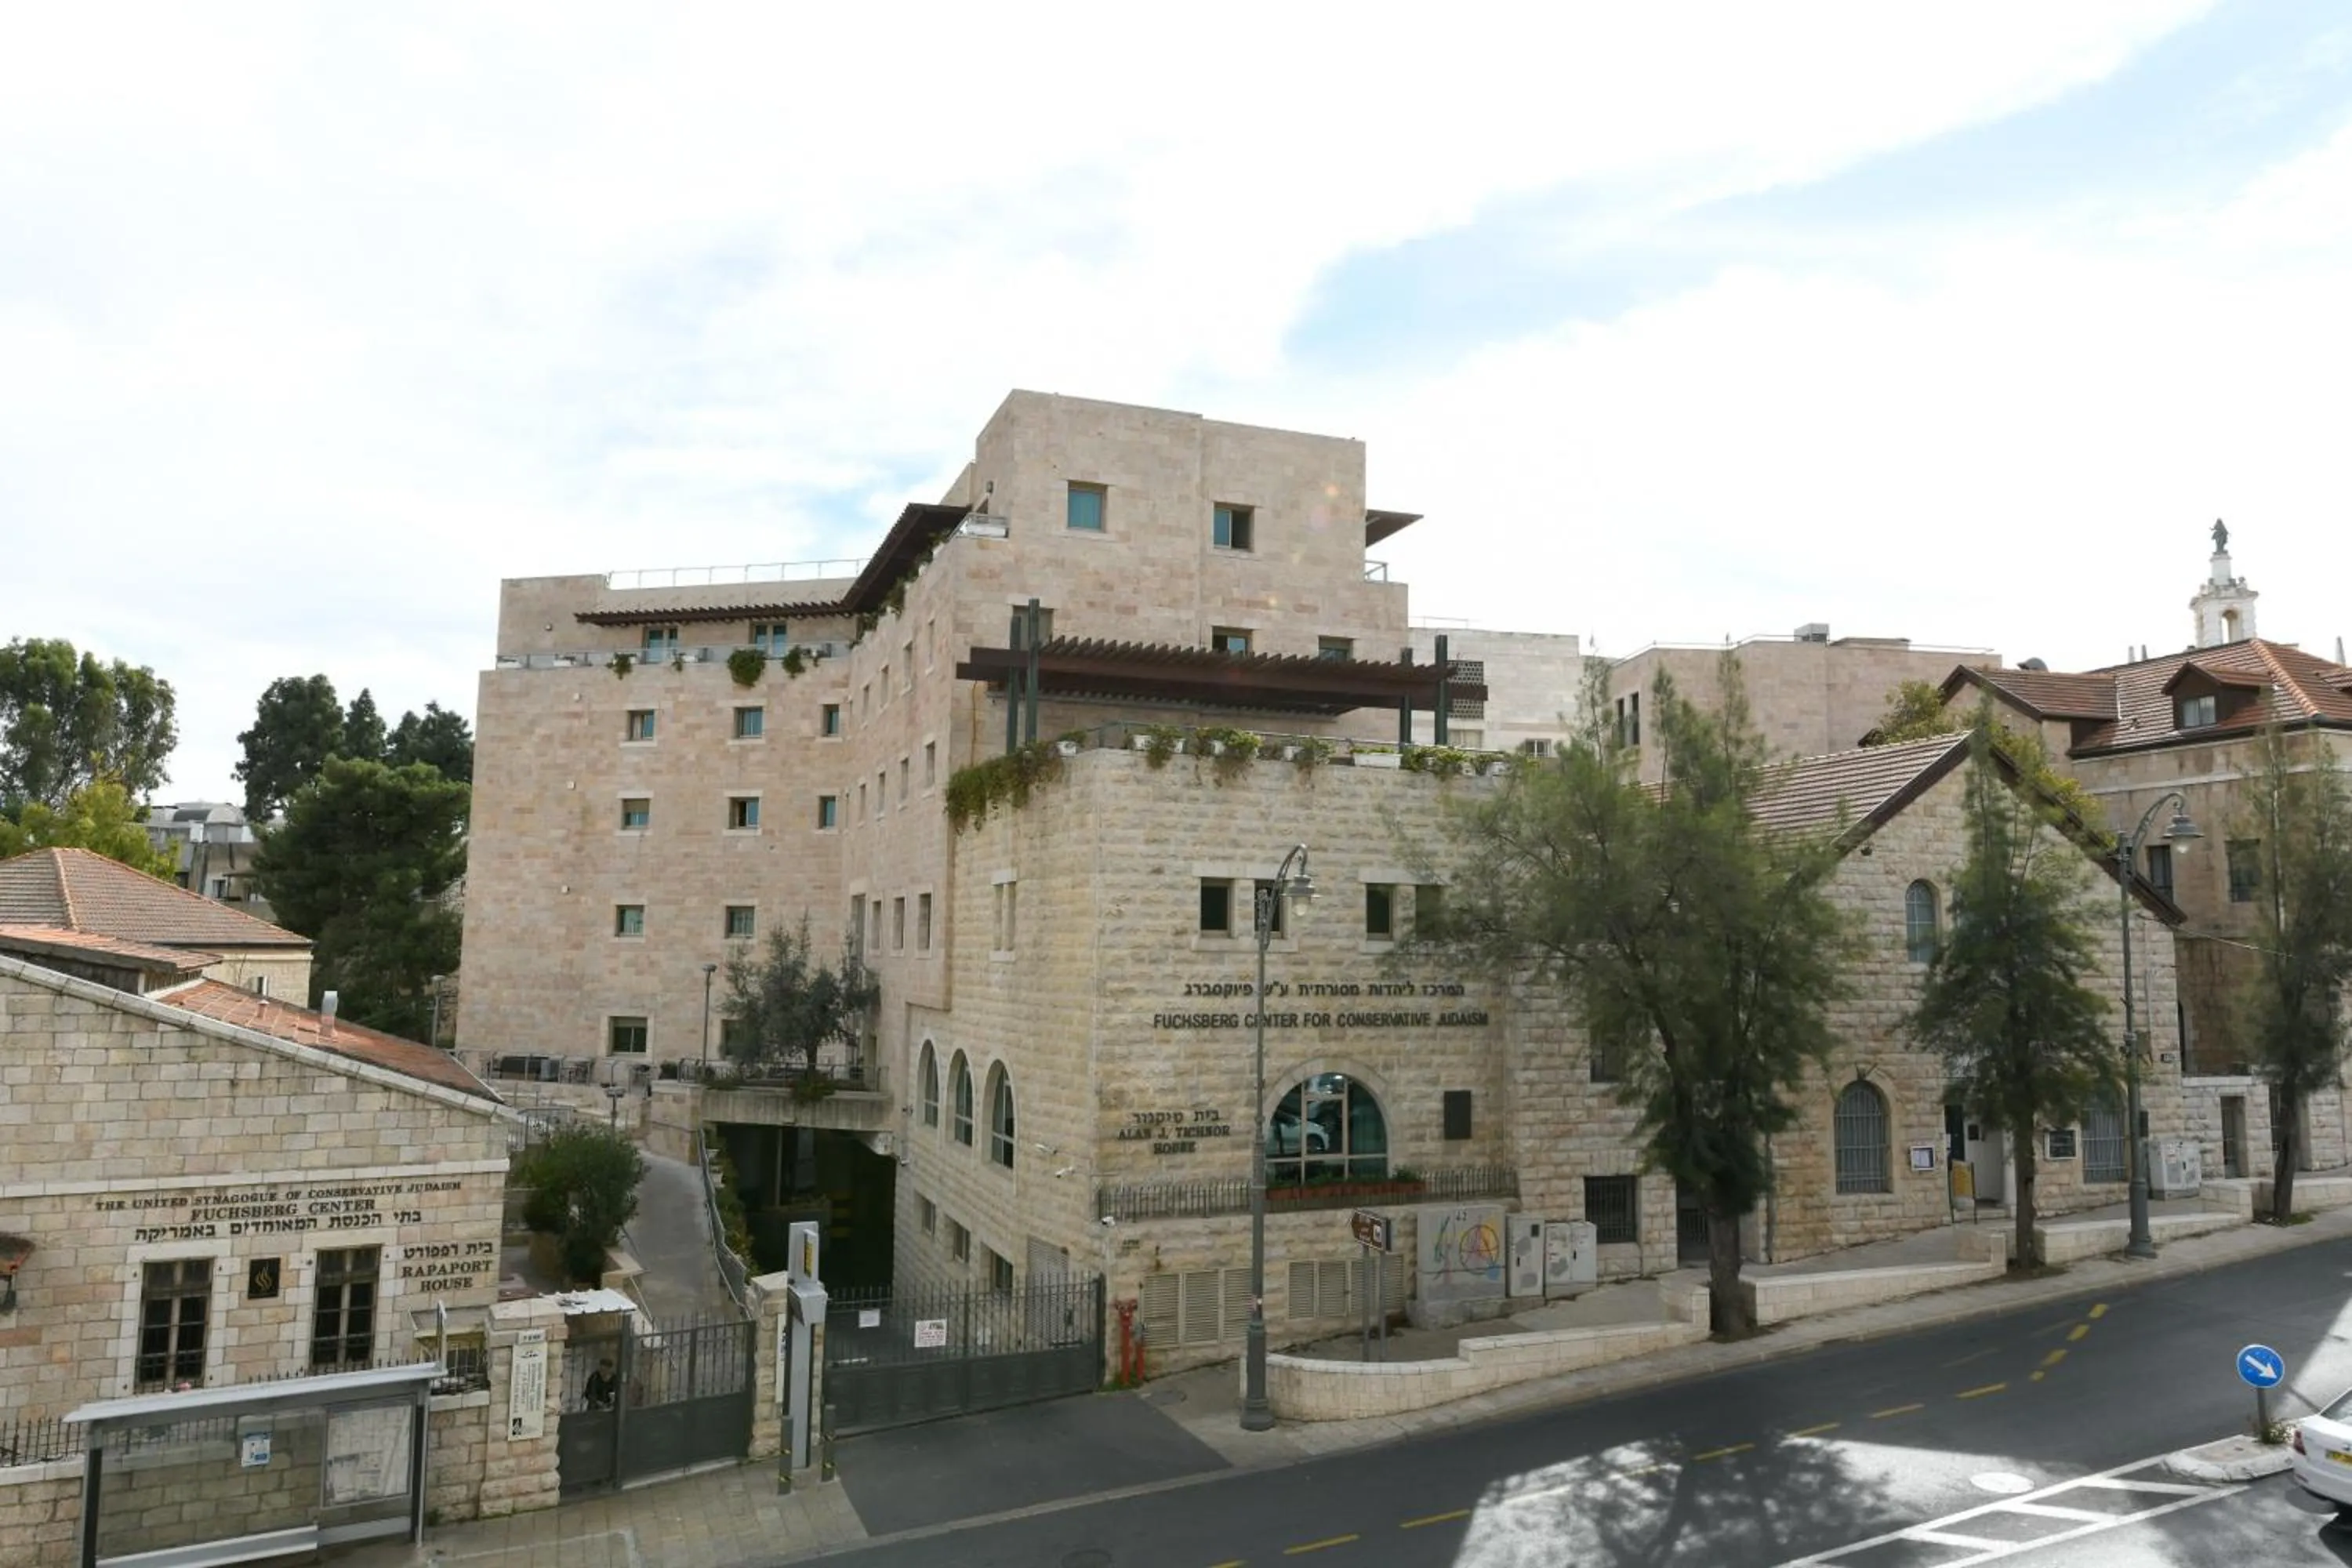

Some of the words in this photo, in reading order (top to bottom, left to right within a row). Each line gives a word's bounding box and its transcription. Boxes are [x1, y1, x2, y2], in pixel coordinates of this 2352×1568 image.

[1184, 983, 1254, 998] פיוקסברג
[1298, 983, 1360, 996] מסורתית
[1368, 981, 1415, 996] ליהדות
[1422, 984, 1465, 996] המרכז
[1154, 1014, 1239, 1029] FUCHSBERG
[1304, 1012, 1331, 1028] FOR
[1338, 1012, 1431, 1027] CONSERVATIVE
[1437, 1011, 1489, 1026] JUDAISM
[1133, 1112, 1184, 1125] טיקנור
[1193, 1109, 1220, 1121] בית
[1118, 1128, 1151, 1140] ALAN
[1175, 1125, 1230, 1138] TICHNOR
[96, 1200, 125, 1211] THE
[132, 1196, 188, 1209] UNITED
[194, 1192, 278, 1206] SYNAGOGUE
[286, 1190, 302, 1200] OF
[307, 1184, 403, 1200] CONSERVATIVE
[408, 1181, 462, 1193] JUDAISM
[190, 1203, 298, 1222] FUCHSBERG
[308, 1199, 376, 1214] CENTER
[394, 1210, 422, 1224] בתי
[229, 1217, 318, 1235] המאוחדים
[328, 1212, 383, 1229] הכנסת
[135, 1224, 216, 1243] באמריקה
[404, 1243, 459, 1258] רפפורט
[466, 1242, 493, 1254] בית
[401, 1260, 493, 1278] RAPAPORT
[420, 1277, 474, 1292] HOUSE
